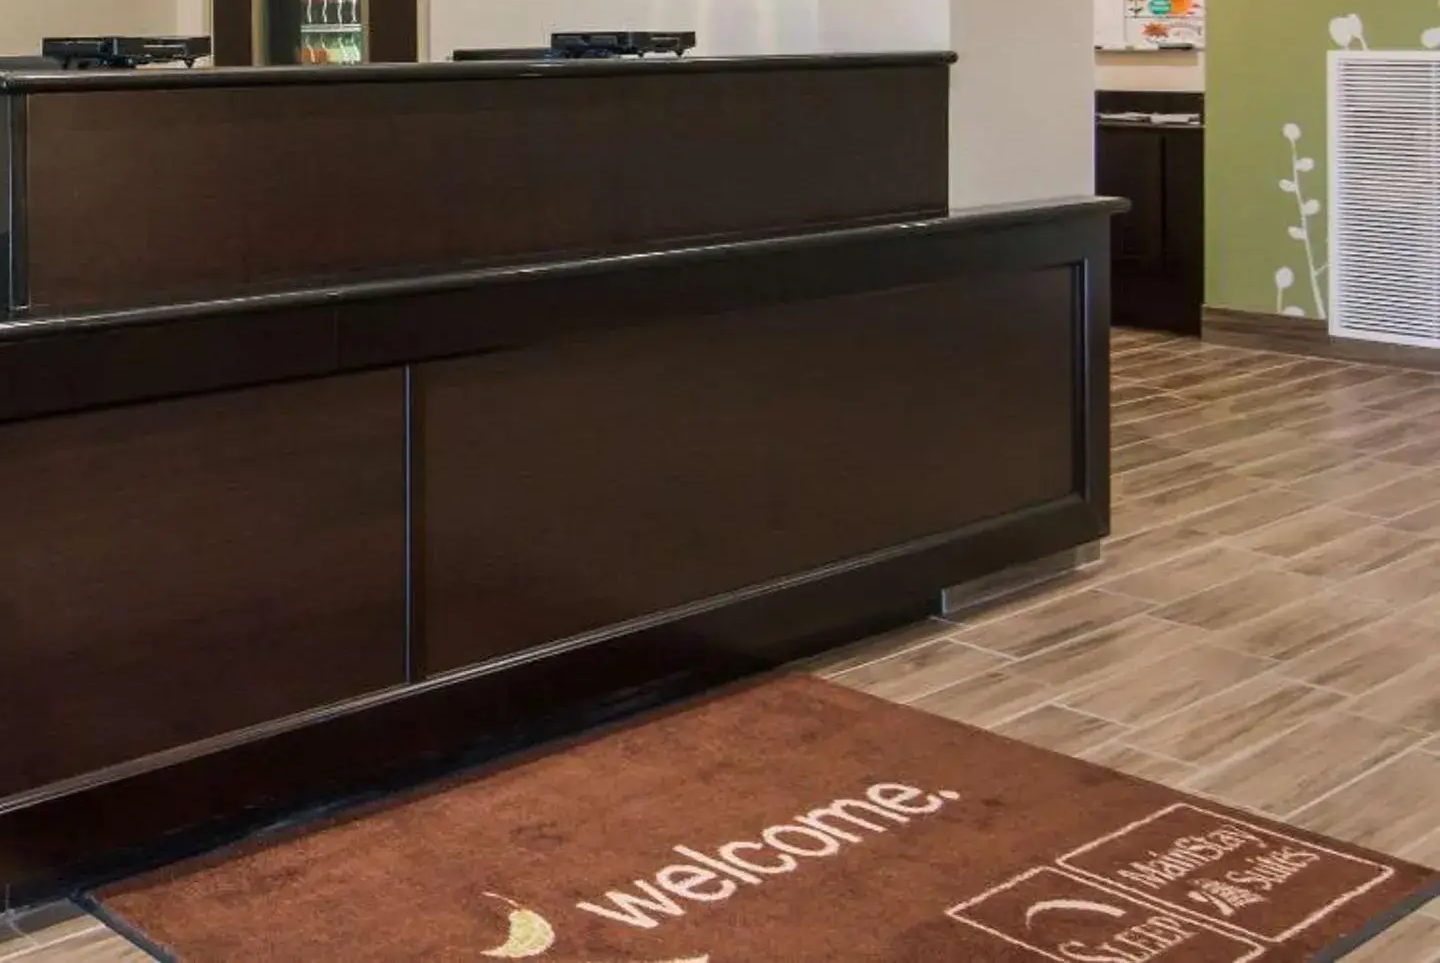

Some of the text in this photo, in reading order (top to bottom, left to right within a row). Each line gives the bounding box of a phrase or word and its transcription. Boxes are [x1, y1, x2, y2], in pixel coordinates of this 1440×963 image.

[575, 782, 961, 929] welcome.
[1116, 824, 1267, 889] MainStay
[1225, 846, 1320, 890] Suites
